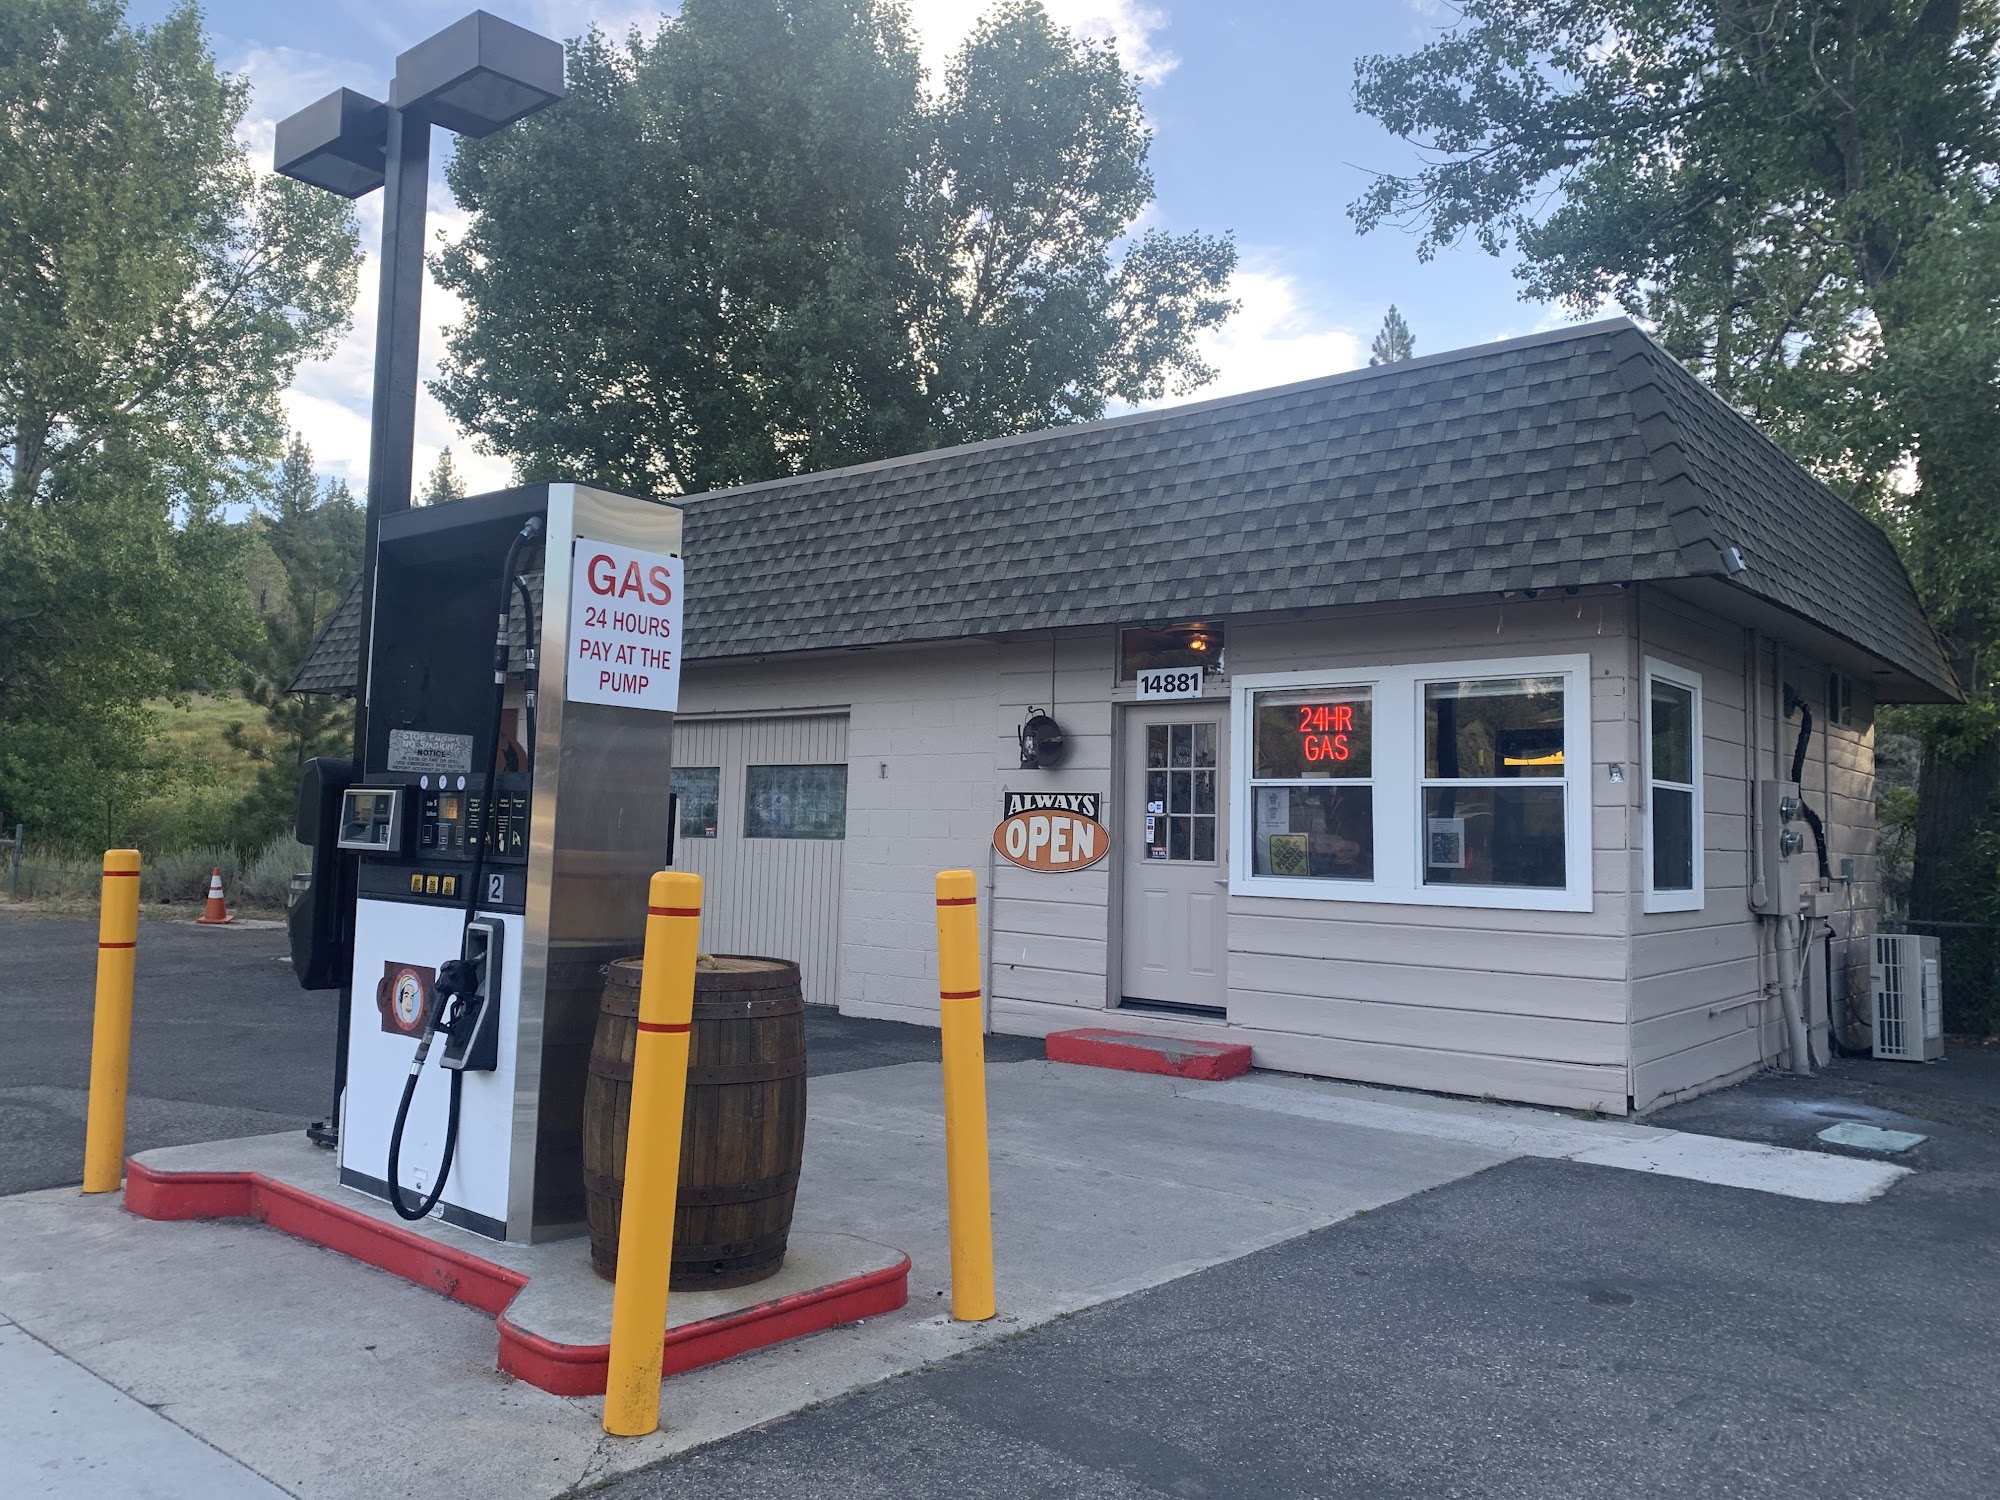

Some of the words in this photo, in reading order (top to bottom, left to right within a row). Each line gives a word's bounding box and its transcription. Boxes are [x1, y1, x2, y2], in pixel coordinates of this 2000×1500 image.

[588, 554, 672, 606] GAS
[585, 606, 607, 628] 24
[613, 611, 670, 638] HOURS
[580, 639, 612, 662] PAY
[615, 644, 636, 664] AT
[641, 648, 671, 670] THE
[600, 670, 649, 694] PUMP
[1141, 673, 1198, 694] 14881
[1300, 706, 1352, 732] 24HR
[402, 731, 426, 740] STOP
[402, 740, 415, 748] NO
[1304, 734, 1349, 761] GAS
[1008, 794, 1095, 816] ALWAYS
[1006, 816, 1094, 863] OPEN
[492, 876, 500, 899] 2
